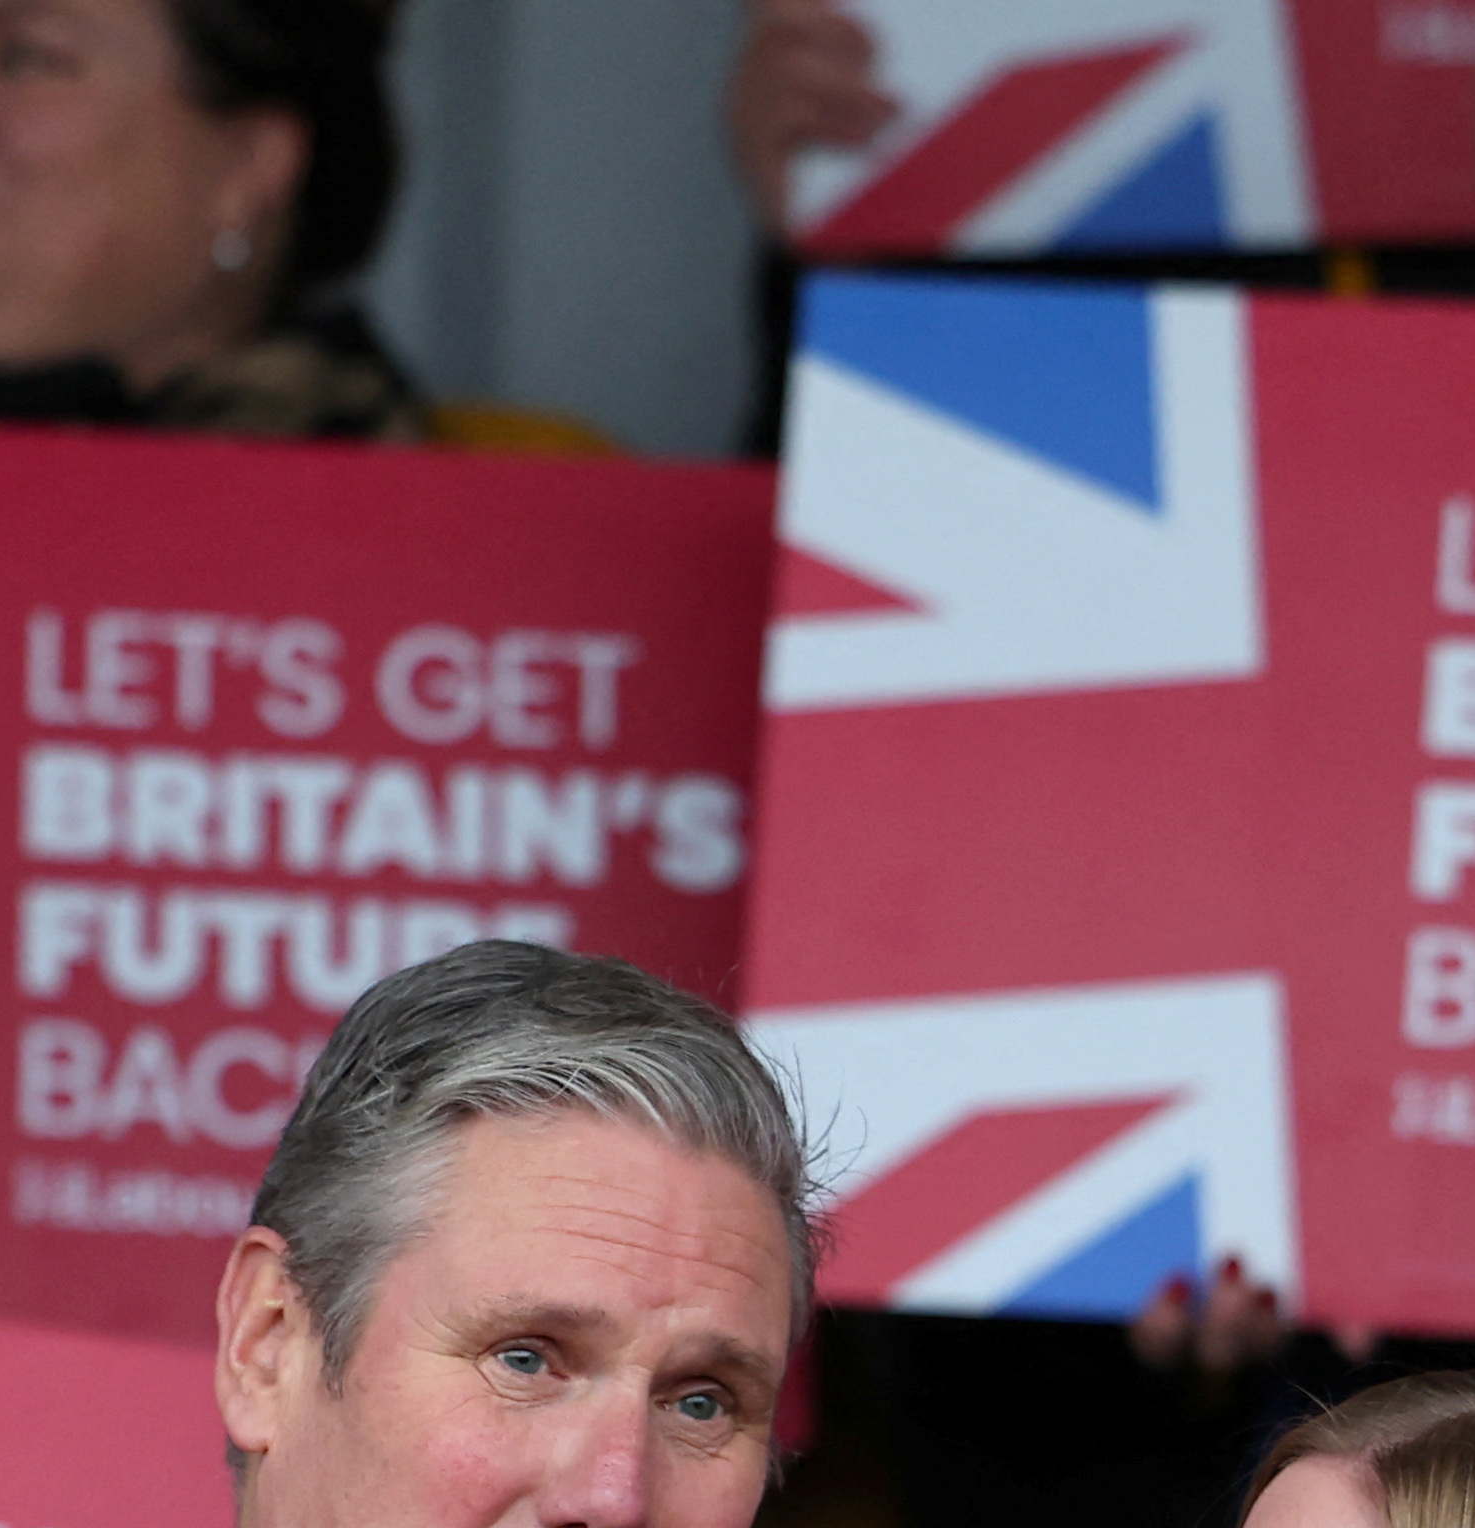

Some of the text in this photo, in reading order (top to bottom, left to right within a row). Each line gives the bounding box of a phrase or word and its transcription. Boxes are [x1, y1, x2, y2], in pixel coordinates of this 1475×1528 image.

[23, 605, 643, 751] LET'S GET
[18, 740, 745, 893] BRITAIN'S
